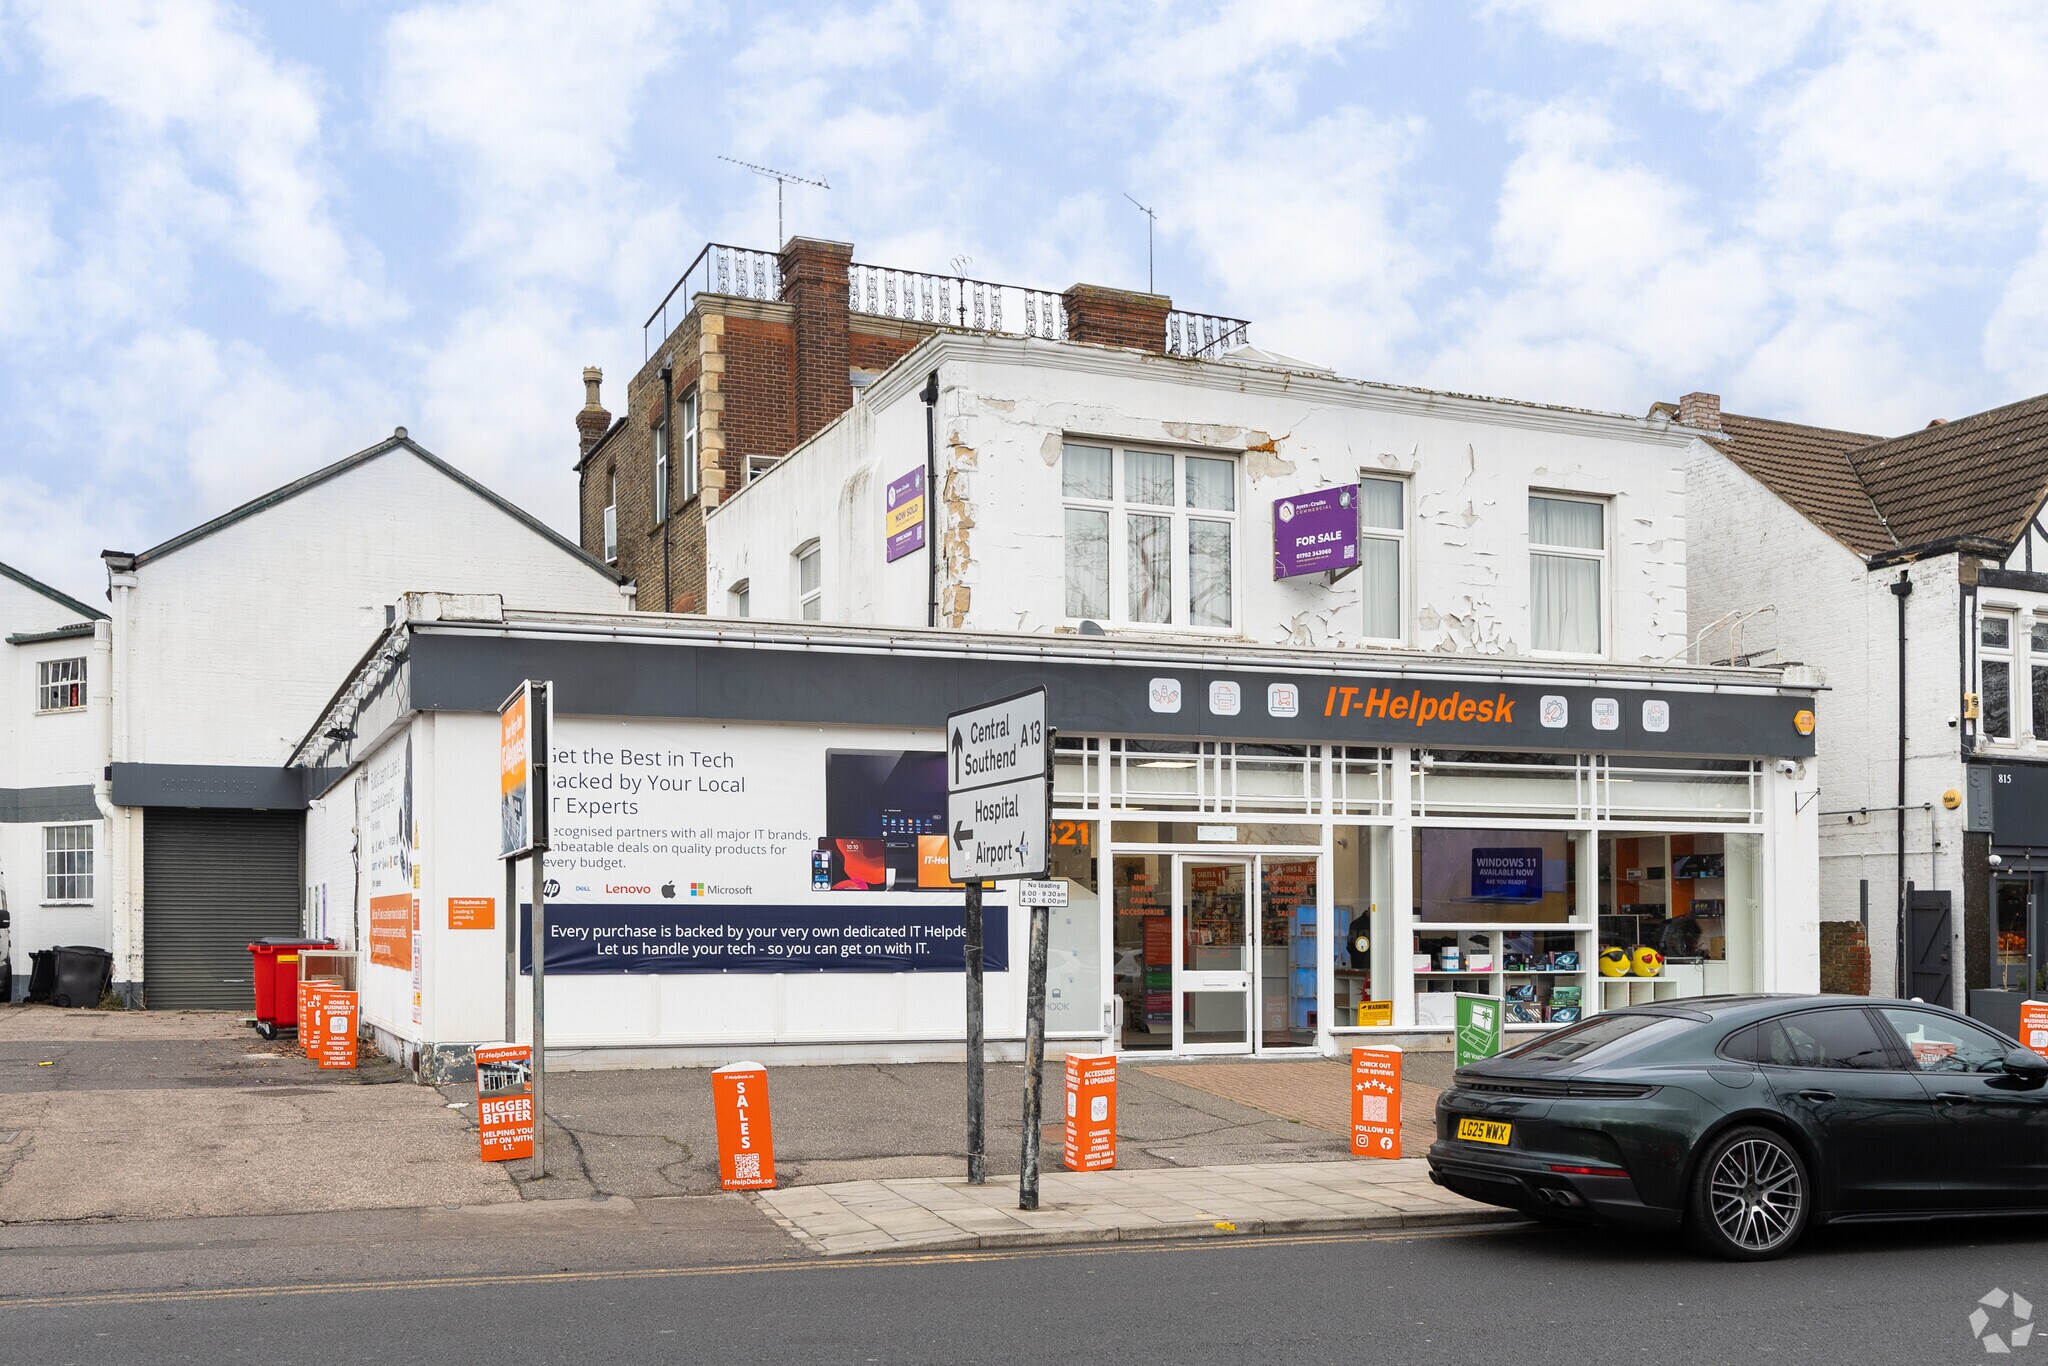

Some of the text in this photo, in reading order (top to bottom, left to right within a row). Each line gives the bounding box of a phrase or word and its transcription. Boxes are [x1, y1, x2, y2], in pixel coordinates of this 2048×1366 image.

[1296, 505, 1332, 515] COMMERCIAL
[1296, 530, 1342, 546] FOR SALE
[1296, 551, 1312, 559] 01702
[1324, 686, 1516, 727] IT-Helpdesk
[971, 714, 1010, 744] Central
[583, 748, 734, 768] the Best in Tech
[965, 744, 1016, 776] Southend
[553, 772, 746, 794] acked by Your Local
[1998, 774, 2012, 784] 815
[567, 798, 638, 818] Experts
[975, 794, 1019, 824] Hospital
[554, 826, 811, 842] ecognised partners with all major IT brands.
[553, 841, 786, 856] nbeatable deals on quality products for
[976, 839, 1012, 868] Airport
[543, 857, 626, 870] every budget.
[924, 856, 948, 865] IT-Hel
[1476, 858, 1536, 868] WINDOWS 11
[1480, 868, 1514, 876] AVAILABLE
[606, 884, 651, 894] Lenovo
[707, 884, 752, 895] Microsoft
[551, 924, 966, 941] Every purchase is backed by your very own dedicated IT Helpde
[597, 942, 618, 955] Let
[622, 944, 638, 955] us
[642, 942, 689, 956] handle
[692, 944, 724, 958] your
[726, 942, 756, 956] tech
[768, 944, 783, 955] so
[786, 944, 811, 958] you
[814, 944, 838, 956] can
[840, 943, 861, 958] get
[864, 944, 882, 956] on
[884, 942, 912, 955] with
[916, 942, 930, 954] IT.
[478, 1050, 526, 1060] IT-HelpDesk.co
[1084, 1068, 1116, 1078] ACCESSORIES
[1090, 1076, 1115, 1085] UPGRADES
[482, 1099, 532, 1114] BIGGER
[482, 1110, 532, 1125] BETTER
[736, 1082, 751, 1150] SALES
[482, 1128, 516, 1138] HELPING
[1355, 1124, 1384, 1134] FOLLOW
[1461, 1120, 1507, 1141] LG25 WWX
[484, 1138, 498, 1146] GET
[512, 1134, 533, 1142] WITH
[1086, 1159, 1100, 1168] MUCH
